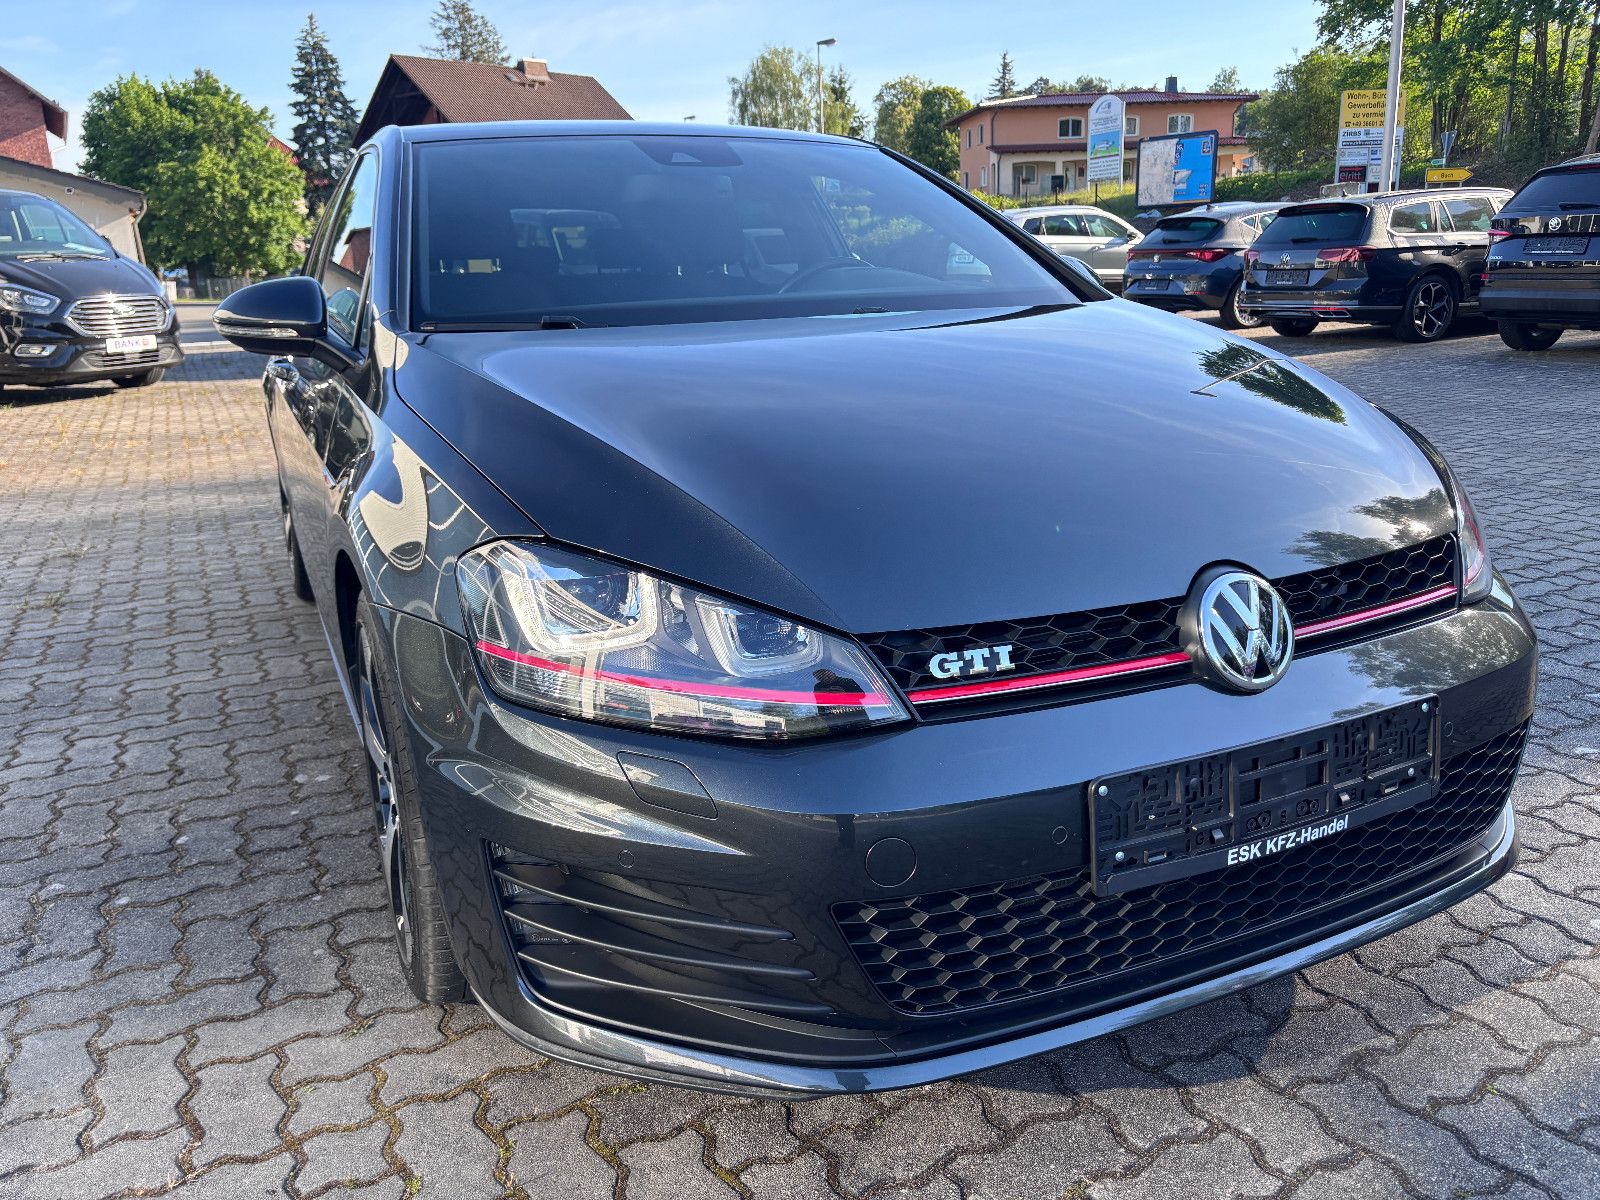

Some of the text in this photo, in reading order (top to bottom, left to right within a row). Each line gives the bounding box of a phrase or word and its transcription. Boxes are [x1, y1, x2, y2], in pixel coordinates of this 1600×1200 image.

[929, 645, 1016, 679] GTI
[1227, 841, 1263, 866] ESK
[1266, 814, 1349, 855] KFZ-Handel
